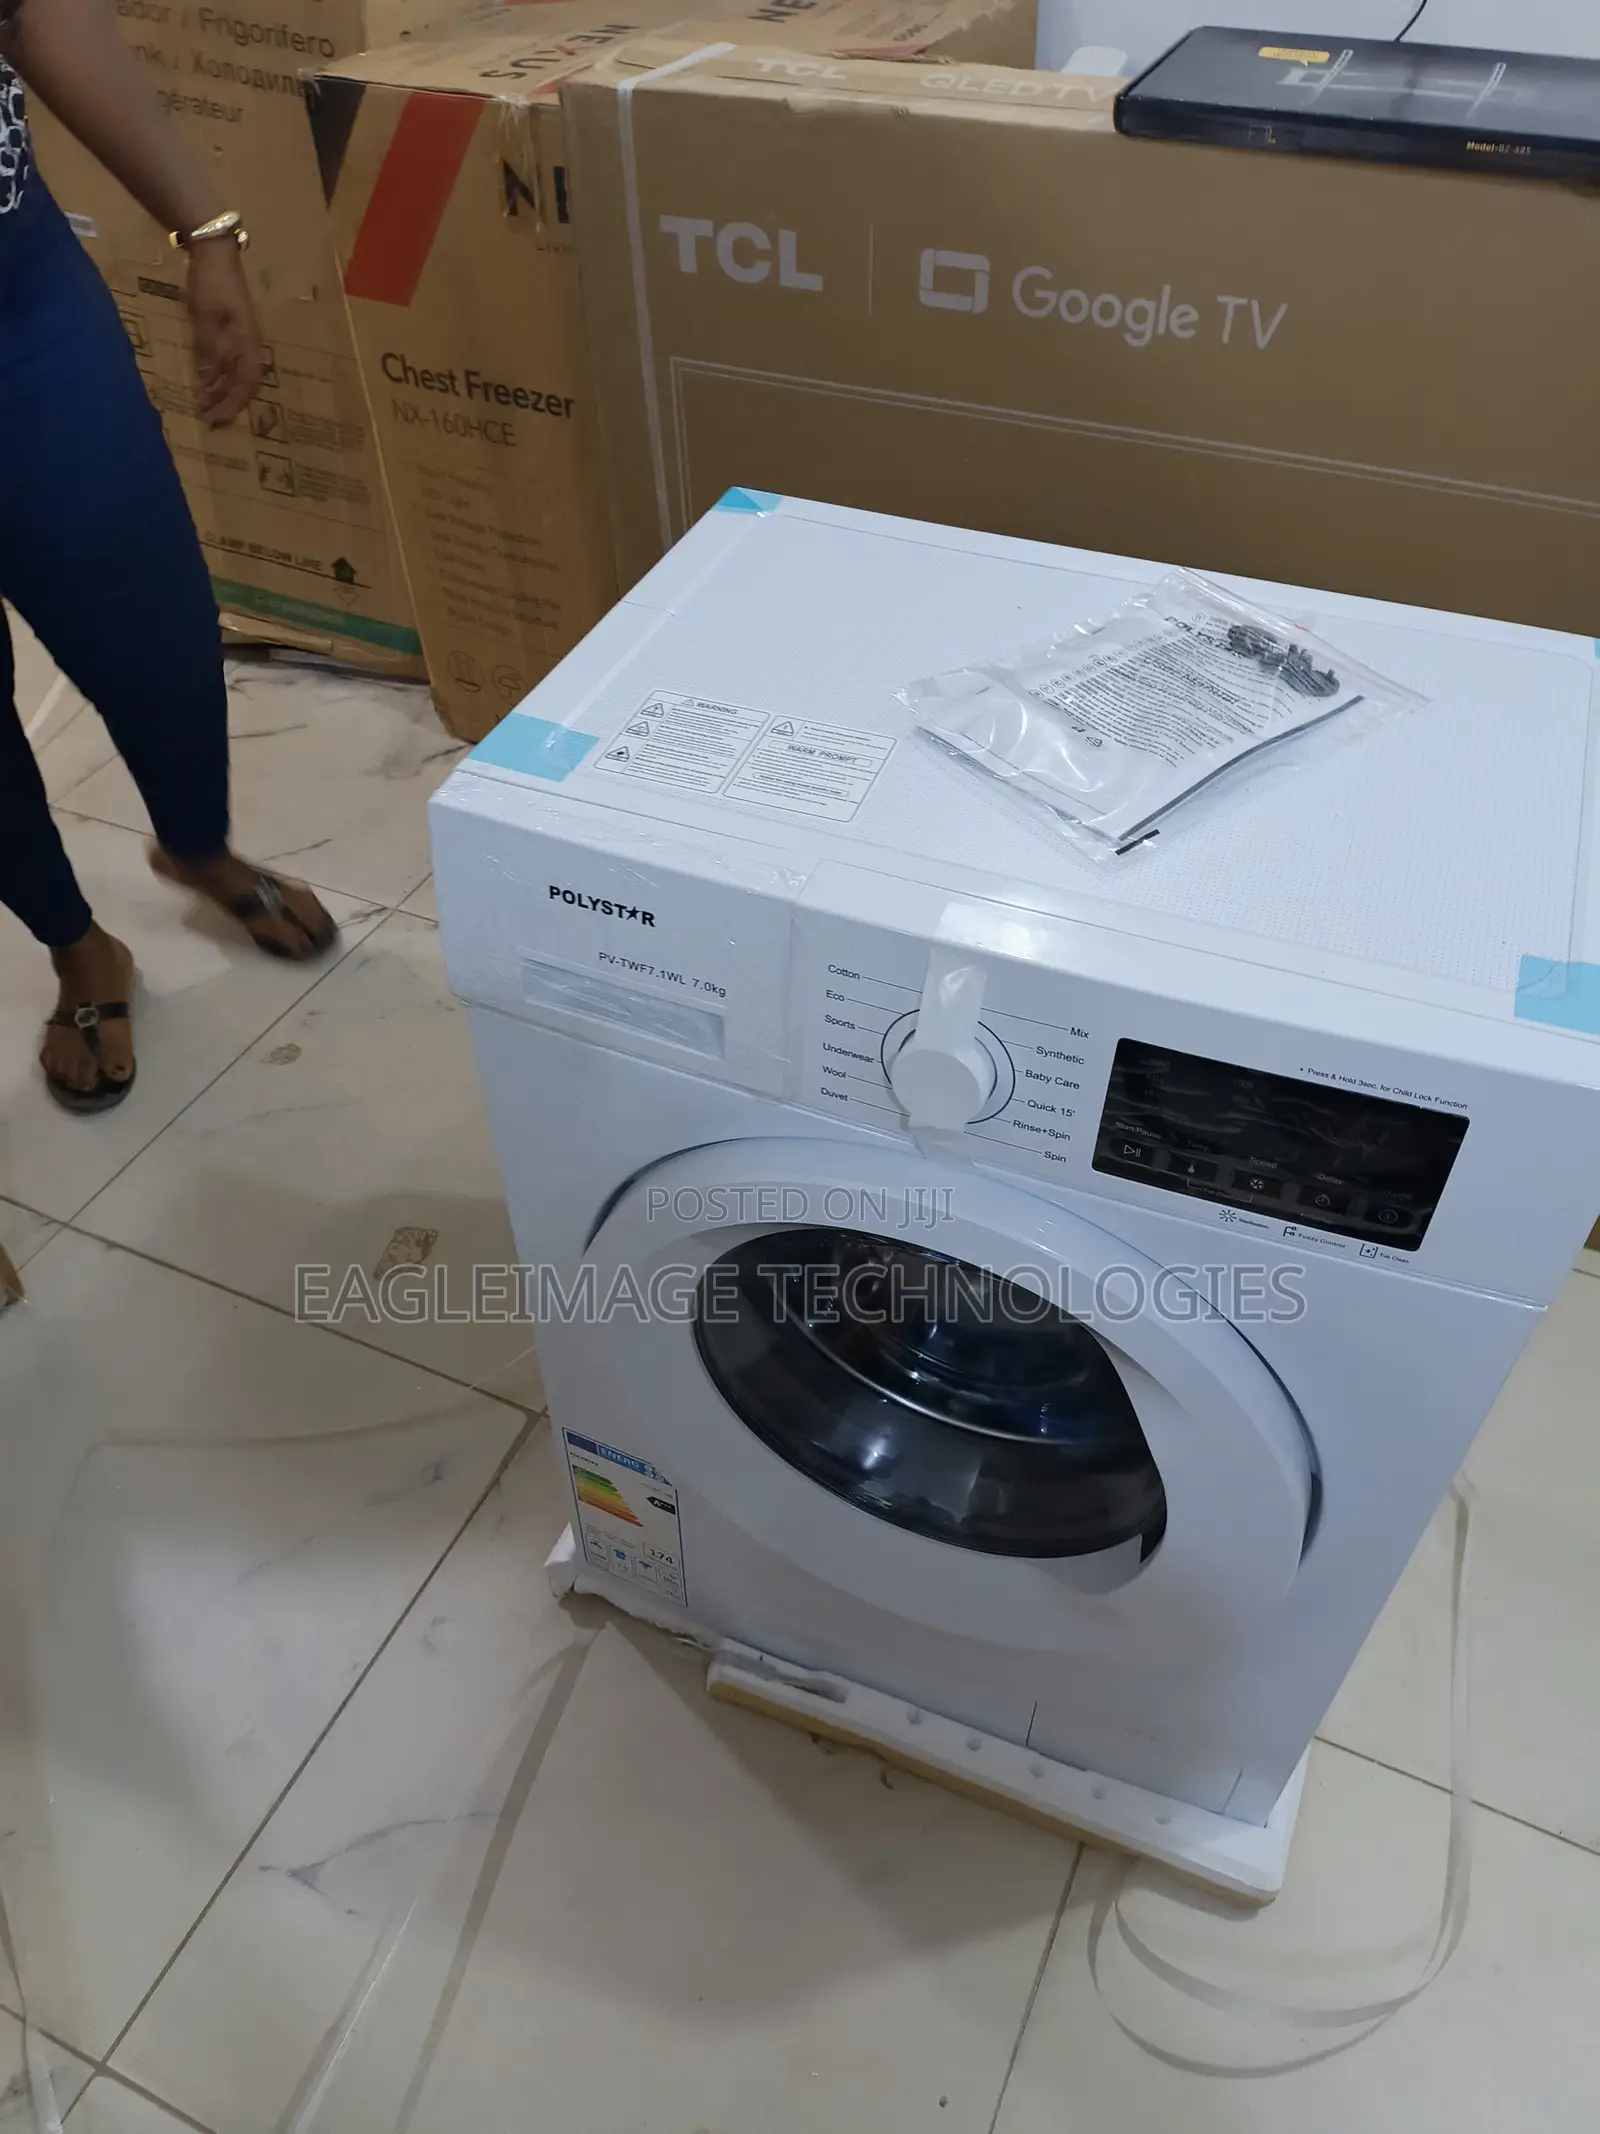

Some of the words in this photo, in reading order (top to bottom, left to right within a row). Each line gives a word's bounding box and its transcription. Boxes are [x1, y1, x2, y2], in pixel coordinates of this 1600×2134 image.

[200, 8, 336, 59] Frigorifero
[757, 57, 848, 81] TCL
[920, 72, 1043, 98] QLED
[660, 215, 823, 292] TCL
[1012, 265, 1199, 347] Google
[1217, 295, 1289, 349] TV
[381, 352, 459, 397] Chest
[464, 369, 577, 419] Freezer
[391, 398, 518, 448] NX-160HCE
[696, 702, 739, 715] WARNING
[819, 751, 860, 764] PROMPT
[599, 952, 687, 985] PV-TWF7.1WL
[692, 978, 727, 998] 7.0kg
[828, 964, 861, 980] Cotton
[826, 989, 845, 1002] Eco
[824, 1014, 856, 1030] Sports
[1070, 1026, 1090, 1039] Mix
[822, 1042, 875, 1064] Underwear
[1036, 1046, 1085, 1065] Synthetic
[822, 1065, 847, 1079] Wool
[1025, 1069, 1052, 1085] Baby
[1054, 1076, 1080, 1090] Care
[821, 1087, 848, 1101] Duvet
[1308, 1067, 1330, 1079] Press
[1339, 1075, 1357, 1085] Hold
[1392, 1087, 1413, 1098] Child
[1414, 1092, 1433, 1103] Lock
[1434, 1096, 1468, 1110] Function
[1027, 1099, 1057, 1114] Quick
[1013, 1119, 1071, 1142] Rinse+Spin
[1044, 1150, 1067, 1163] Spin
